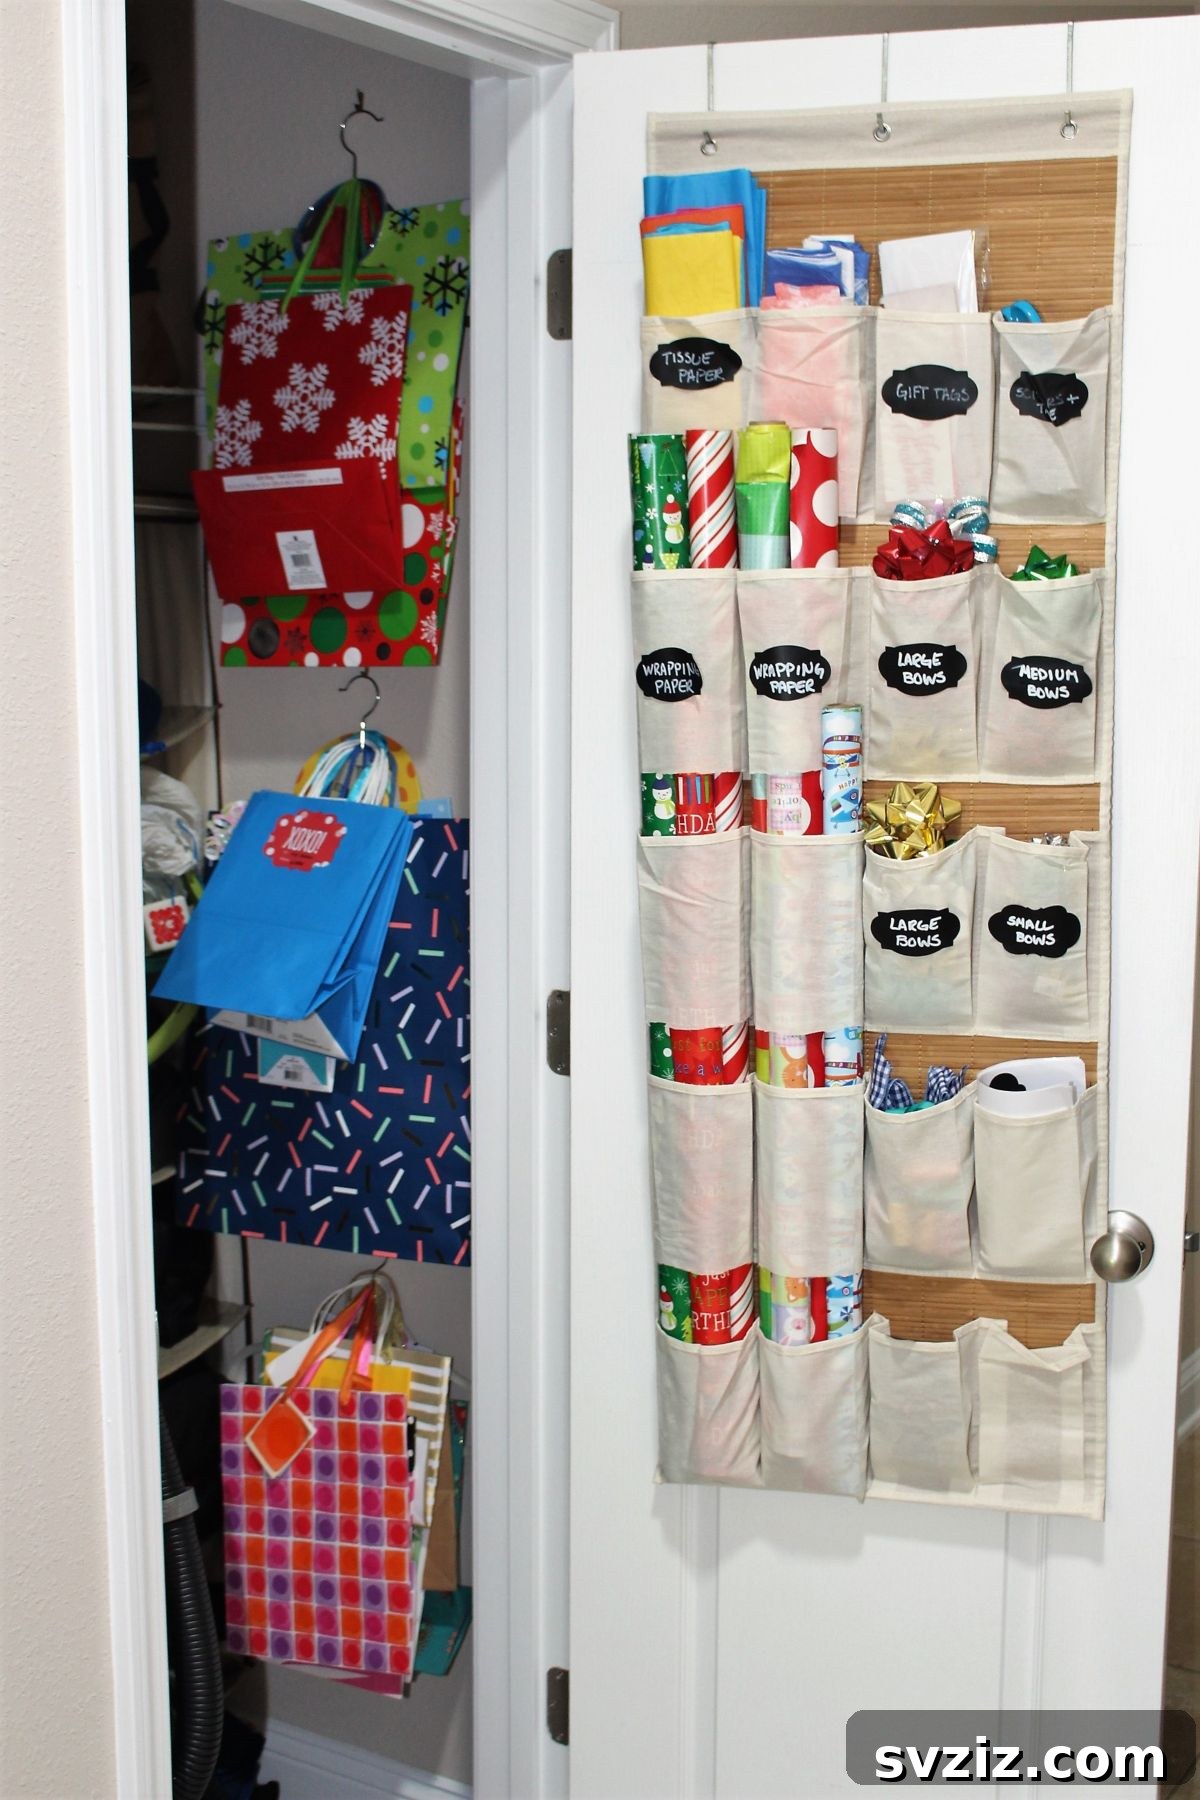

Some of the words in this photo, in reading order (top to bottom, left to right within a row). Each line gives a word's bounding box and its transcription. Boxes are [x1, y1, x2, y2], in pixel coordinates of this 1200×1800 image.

[662, 350, 715, 366] TISSUE
[678, 367, 726, 384] PAPER
[896, 382, 929, 401] GIFT
[934, 387, 970, 402] TAGS
[897, 651, 944, 669] LARGE
[753, 661, 825, 680] WRAPPING
[902, 670, 947, 686] BOWS
[1018, 664, 1079, 683] MEDIUM
[654, 678, 695, 695] PAPER
[769, 678, 816, 695] PAPER
[1026, 684, 1071, 699] BOWS
[676, 813, 716, 834] HDA
[282, 826, 328, 854] XOXO!
[889, 916, 942, 932] LARGE
[1006, 915, 1055, 932] SMALL
[895, 934, 942, 948] BOWS
[1015, 931, 1056, 946] BOWS
[697, 1064, 705, 1076] a
